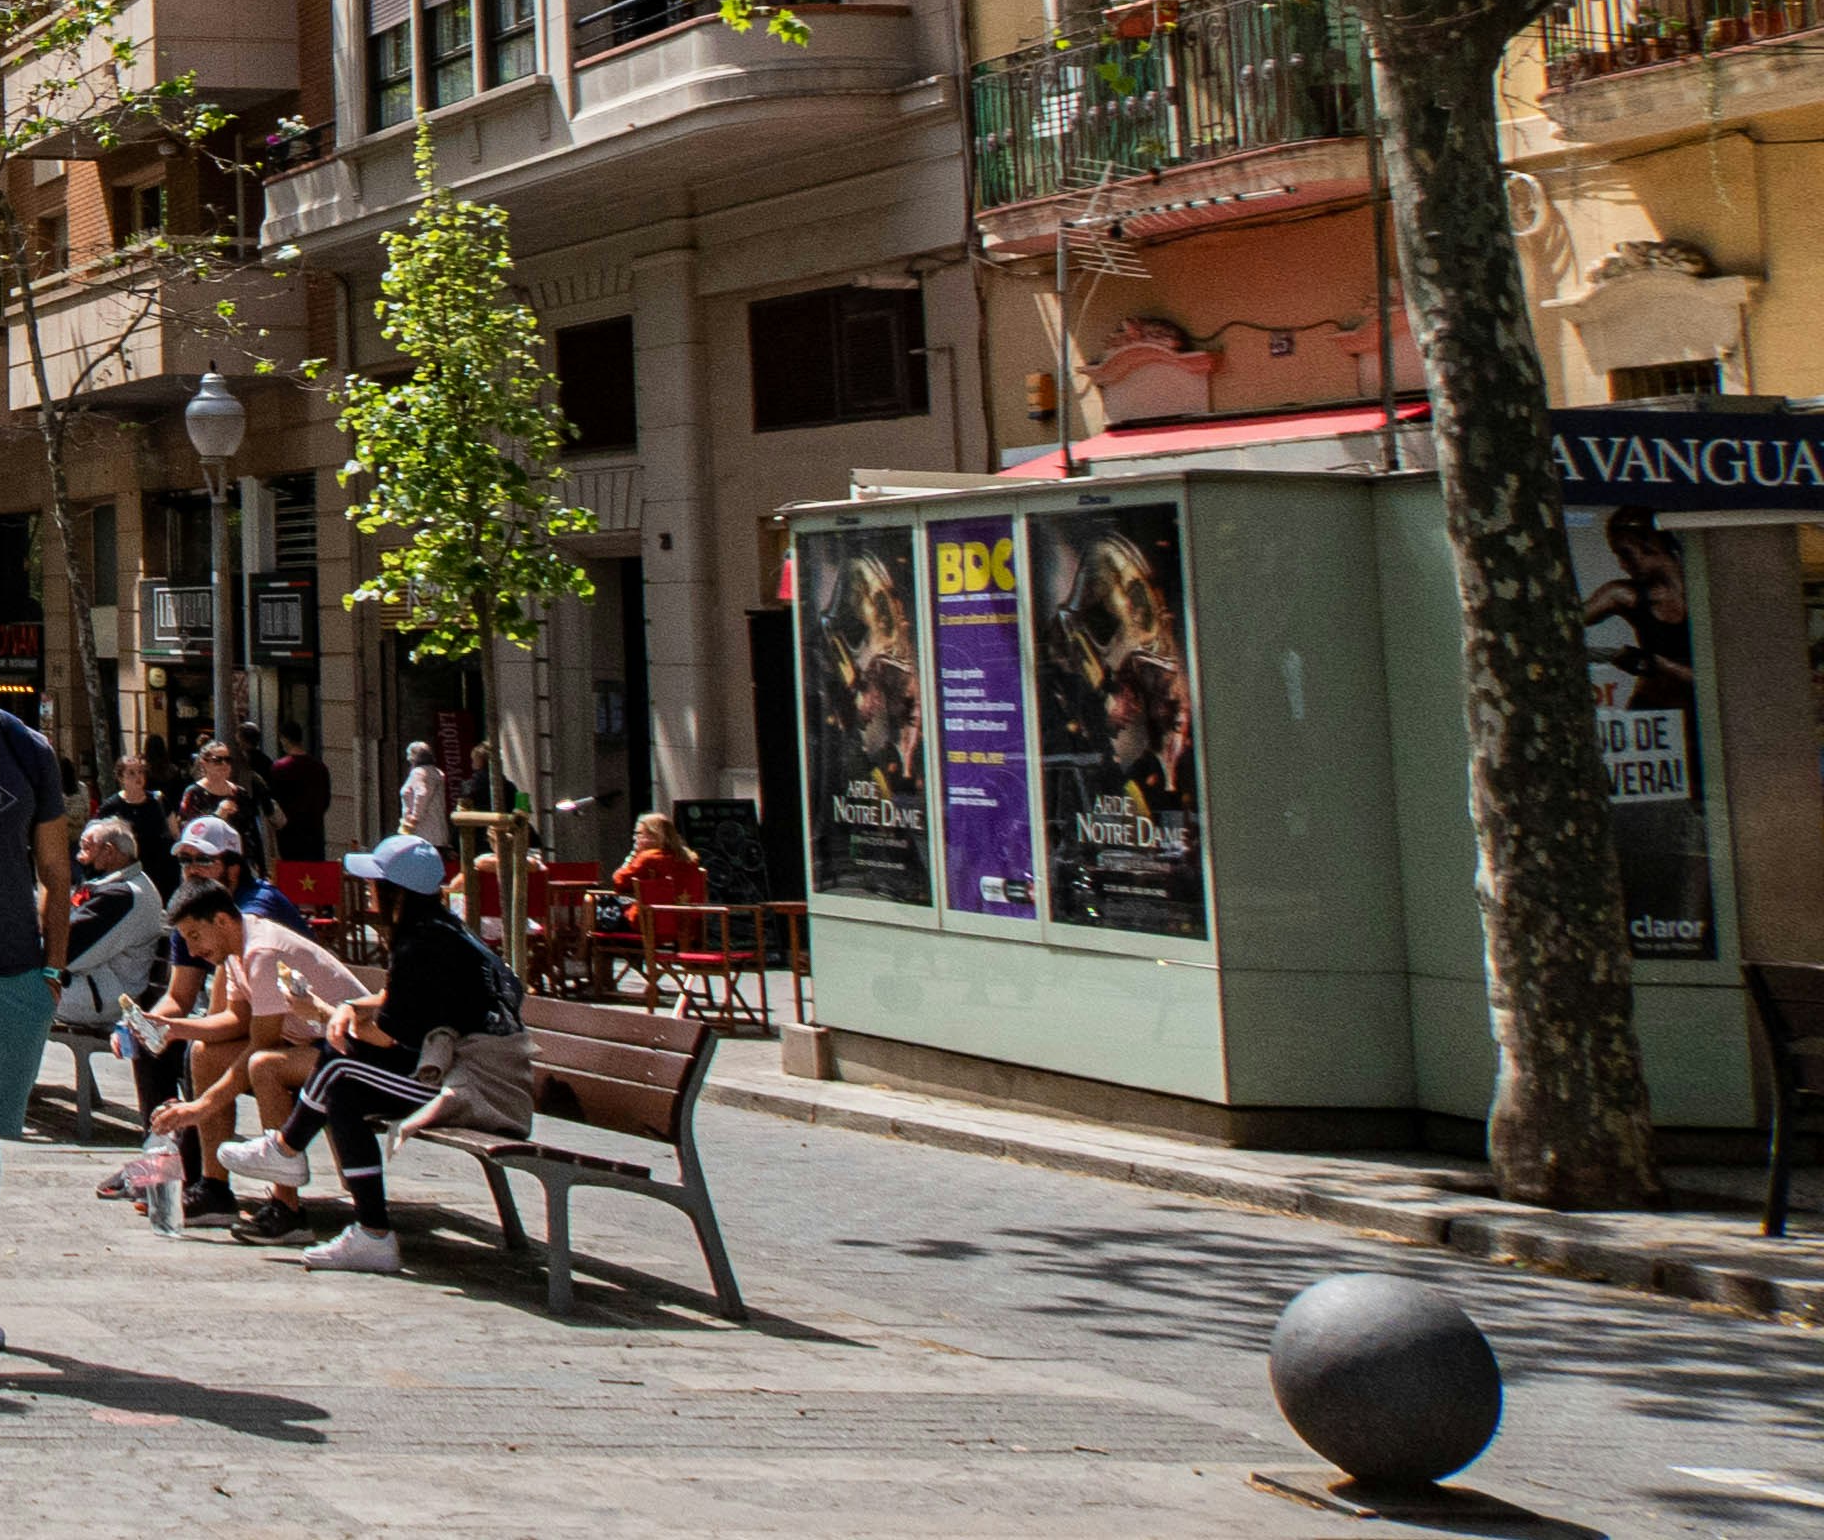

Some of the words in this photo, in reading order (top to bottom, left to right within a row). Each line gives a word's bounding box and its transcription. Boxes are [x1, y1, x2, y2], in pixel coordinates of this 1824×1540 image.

[1577, 434, 1824, 487] VANGUA
[1635, 716, 1671, 751] DE
[846, 779, 880, 800] ARDE
[1606, 758, 1684, 797] VERA!
[832, 794, 880, 827] NOTRE
[880, 798, 926, 831] DAME
[1093, 794, 1135, 817] ARDE
[1075, 811, 1135, 847] NOTRE
[1135, 816, 1191, 851] DAME
[1630, 913, 1704, 940] claror
